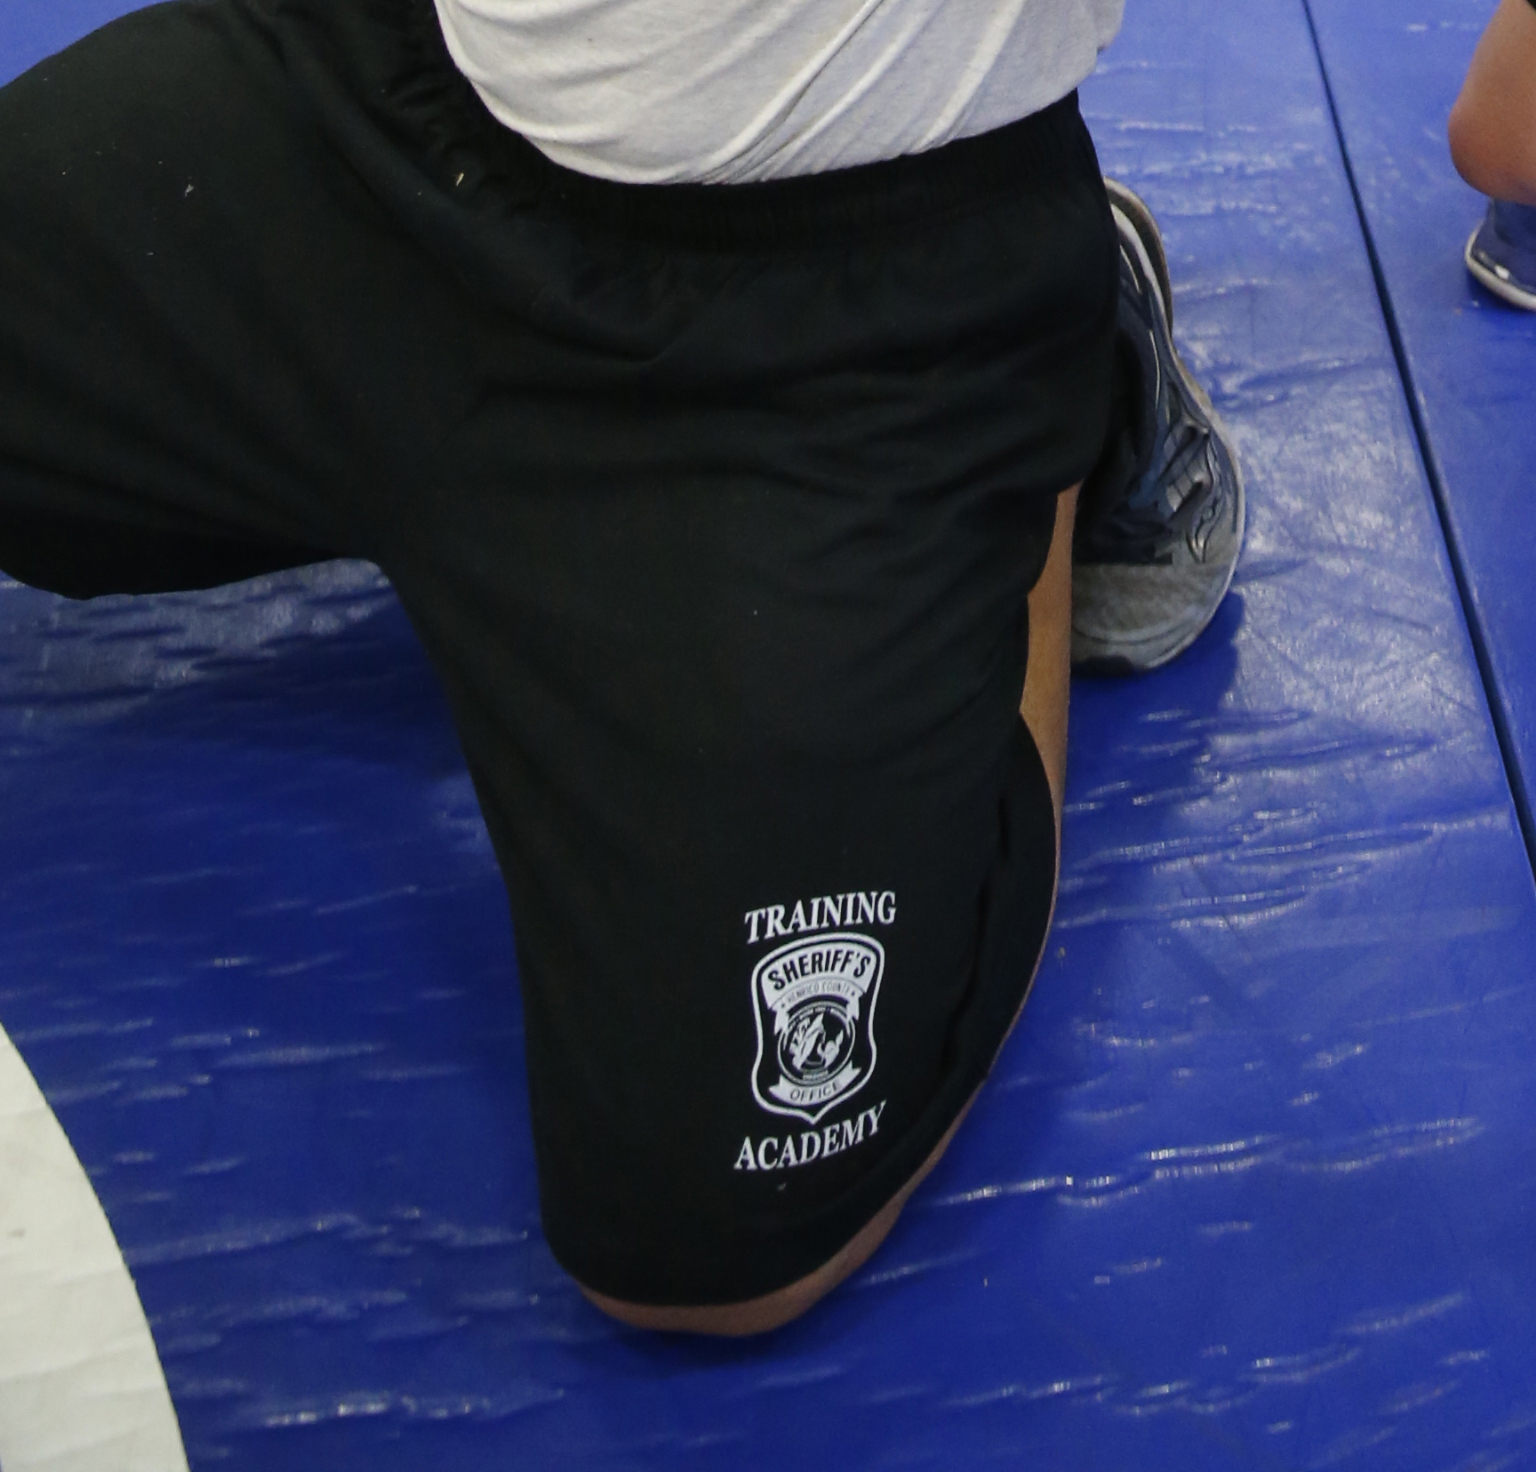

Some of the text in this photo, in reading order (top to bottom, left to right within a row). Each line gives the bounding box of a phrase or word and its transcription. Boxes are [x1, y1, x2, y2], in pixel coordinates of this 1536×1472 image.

[744, 890, 896, 945] TRAINING
[768, 949, 871, 991] SHERIFF'S
[790, 1080, 840, 1102] OFFICE
[733, 1099, 887, 1171] ACADEMY
